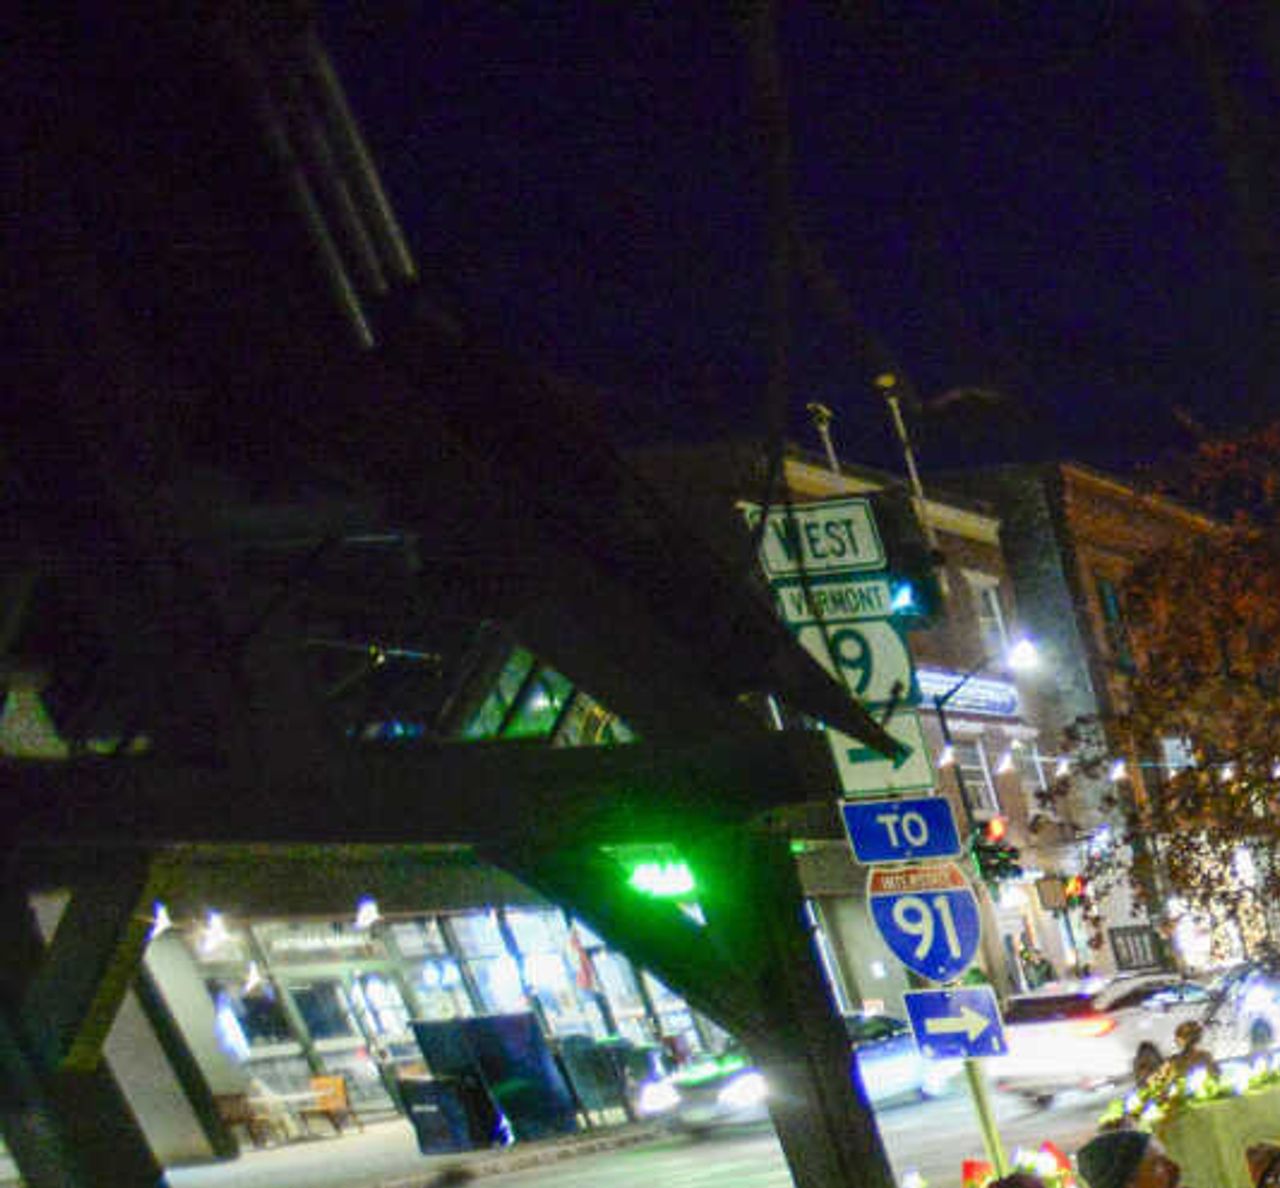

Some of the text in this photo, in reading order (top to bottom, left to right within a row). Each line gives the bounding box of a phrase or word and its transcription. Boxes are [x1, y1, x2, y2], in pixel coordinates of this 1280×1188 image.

[771, 517, 861, 562] WEST
[789, 584, 884, 617] VRMONT
[832, 627, 873, 696] 9
[875, 812, 928, 847] TO
[892, 896, 962, 960] 91
